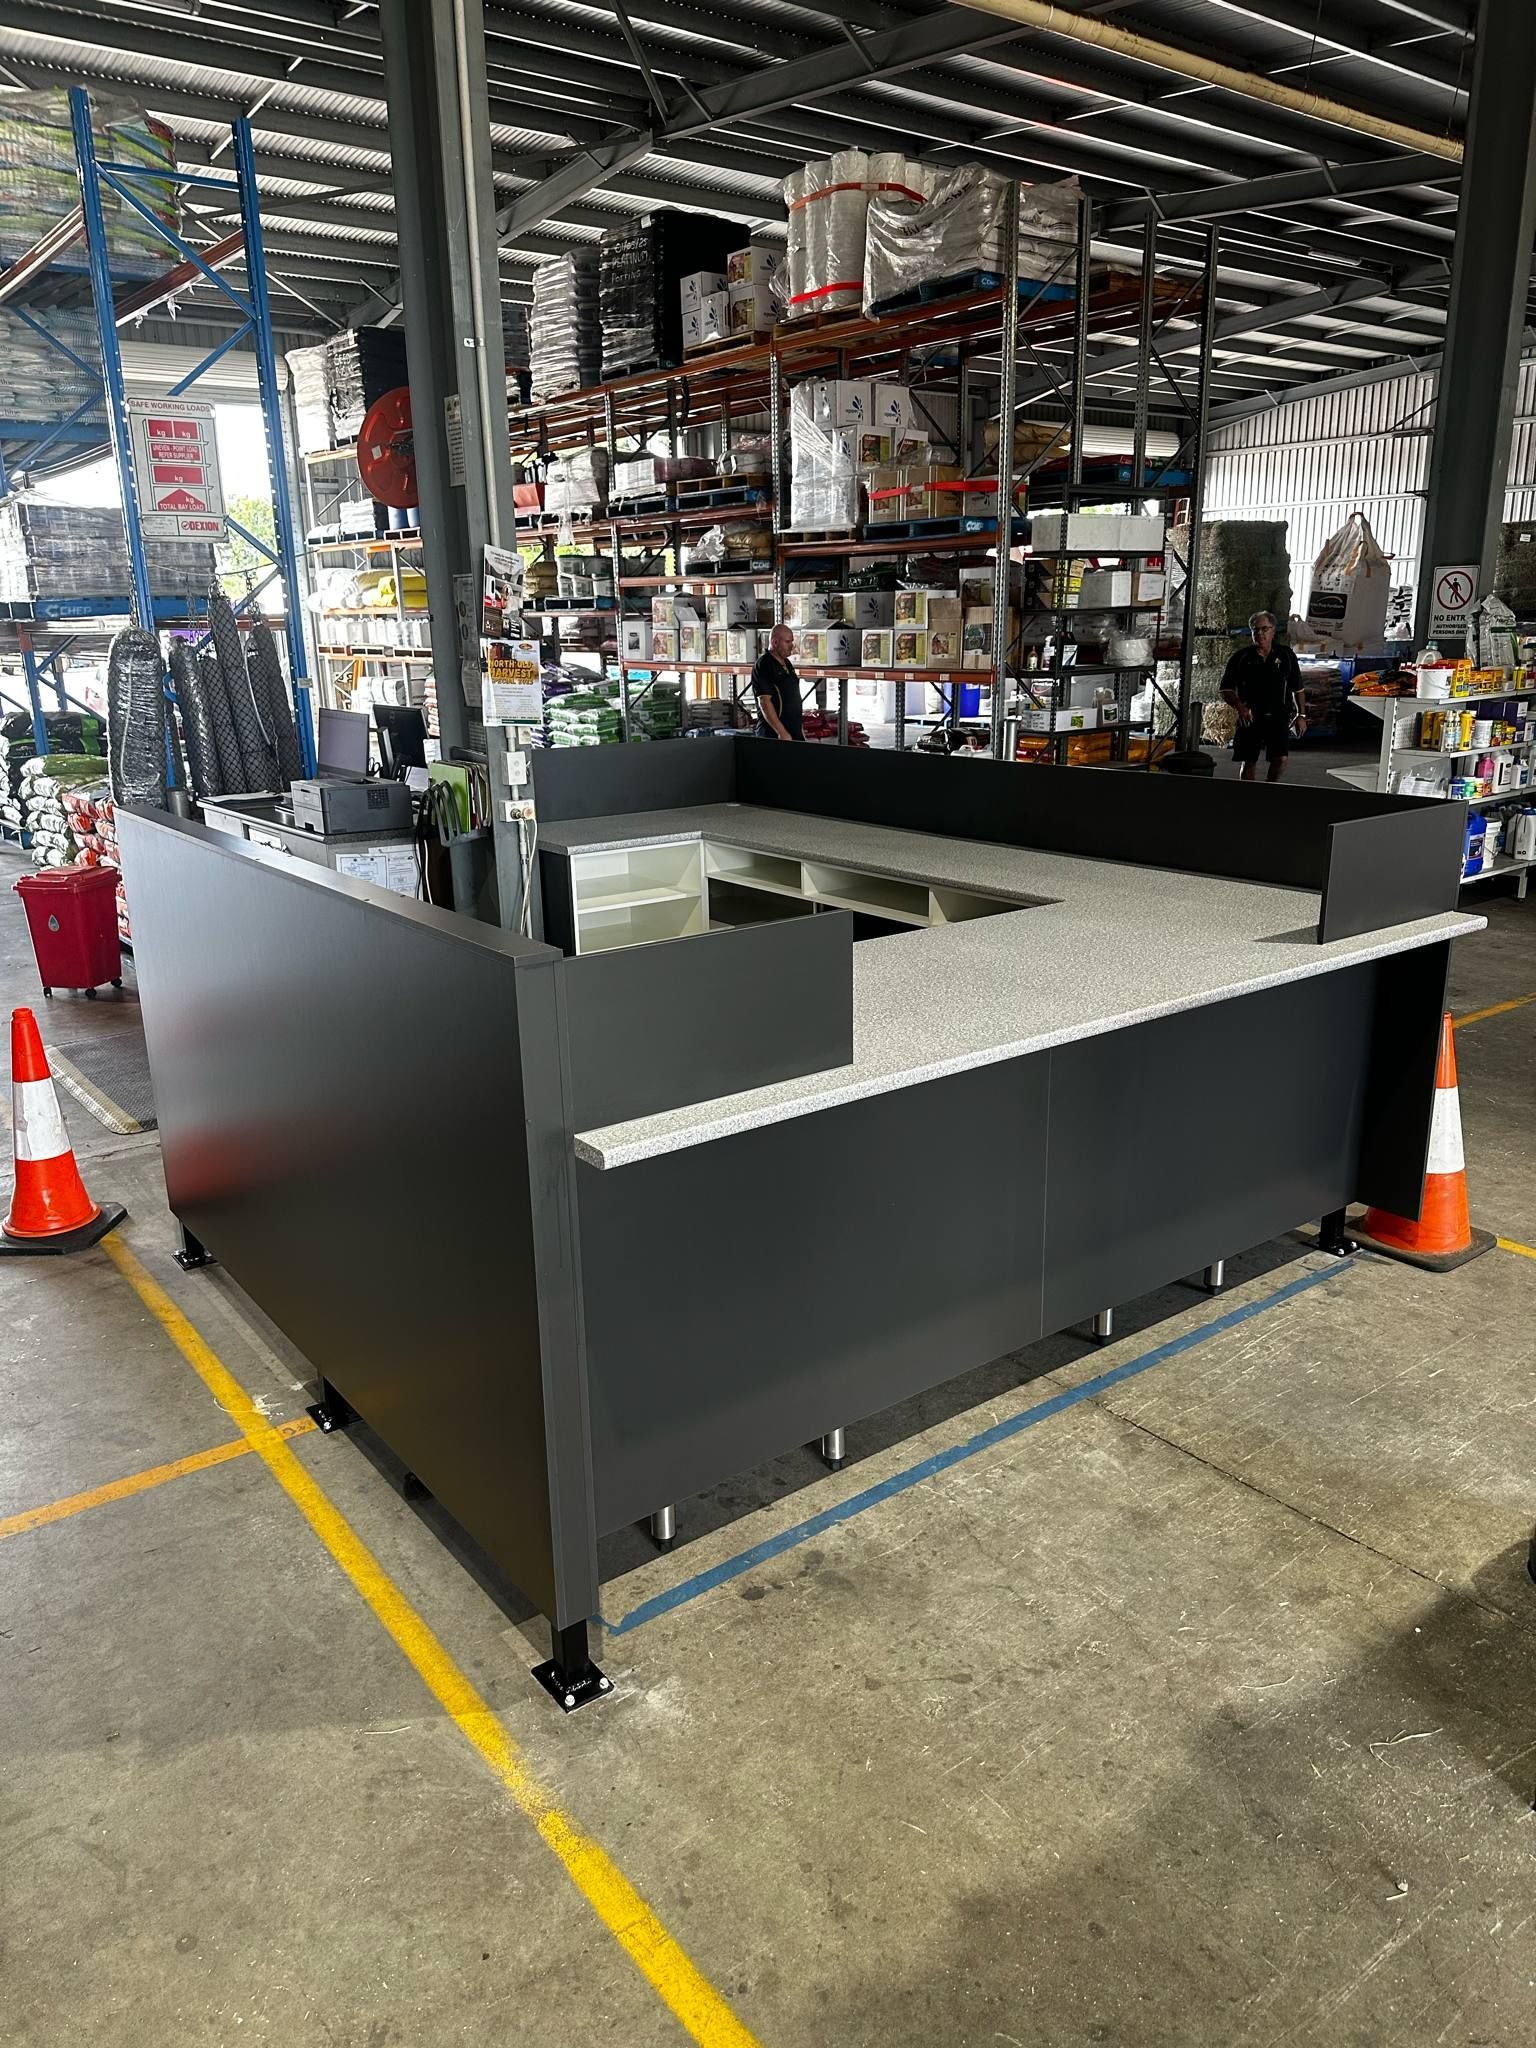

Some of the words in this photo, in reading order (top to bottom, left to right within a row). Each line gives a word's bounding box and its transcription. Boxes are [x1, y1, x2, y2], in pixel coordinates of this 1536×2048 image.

[131, 400, 150, 408] SAFE
[151, 402, 185, 411] WORKING
[187, 404, 211, 412] LOADS
[156, 429, 166, 438] kg
[182, 430, 191, 439] kg
[174, 475, 183, 483] kg
[186, 496, 195, 504] kg
[190, 522, 219, 531] DEXION
[1434, 614, 1445, 622] NO
[1446, 614, 1466, 622] ENTR
